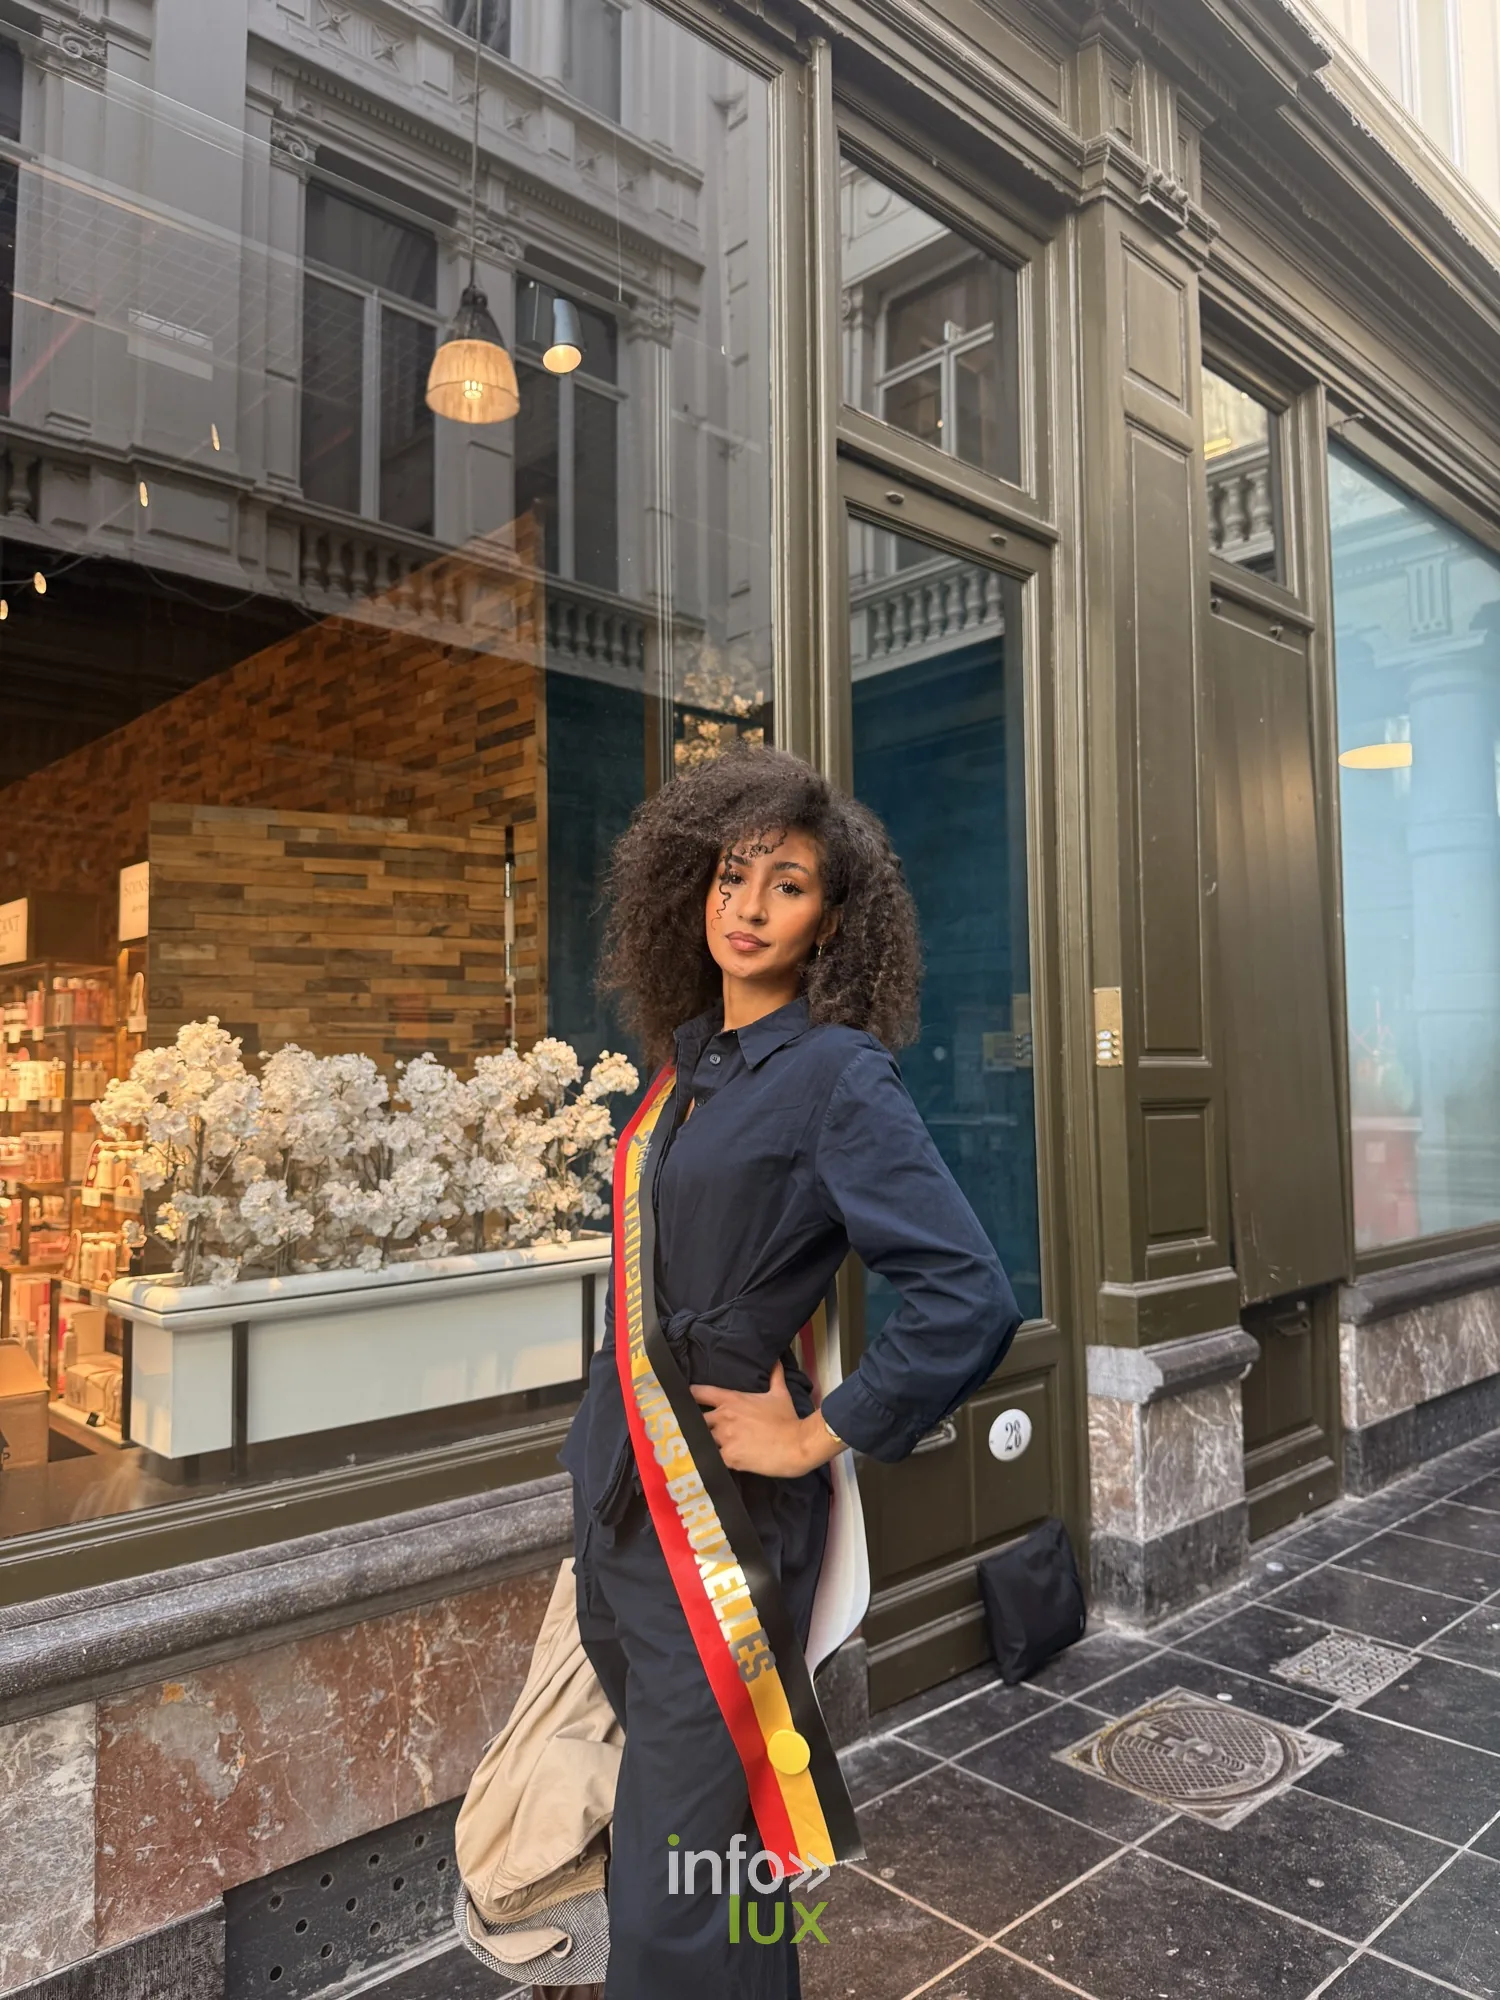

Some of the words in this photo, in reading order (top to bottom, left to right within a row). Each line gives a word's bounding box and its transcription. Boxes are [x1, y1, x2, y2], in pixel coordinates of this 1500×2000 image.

[623, 1190, 647, 1364] DAUPHINE
[631, 1370, 688, 1467] MISS
[666, 1472, 776, 1682] BRUXELLES
